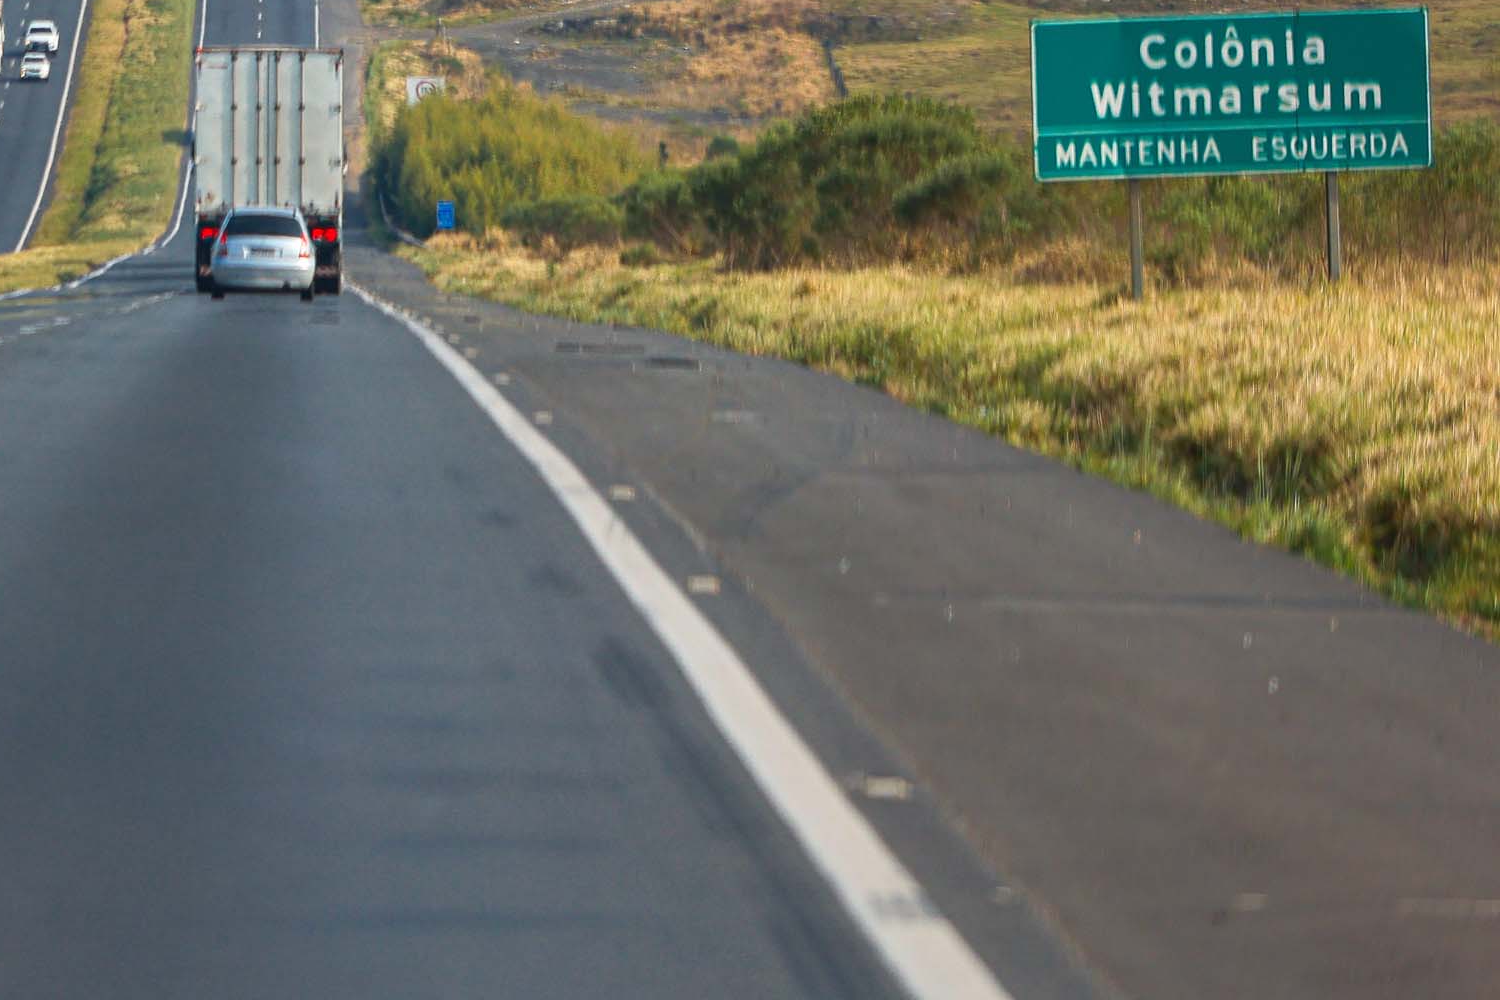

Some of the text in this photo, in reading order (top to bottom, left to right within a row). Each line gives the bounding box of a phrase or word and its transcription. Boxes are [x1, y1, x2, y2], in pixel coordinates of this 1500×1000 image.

[1139, 26, 1326, 70] Colônia
[1090, 80, 1382, 119] Witmarsum
[1055, 130, 1410, 169] MANTENHA ESQUERDA
